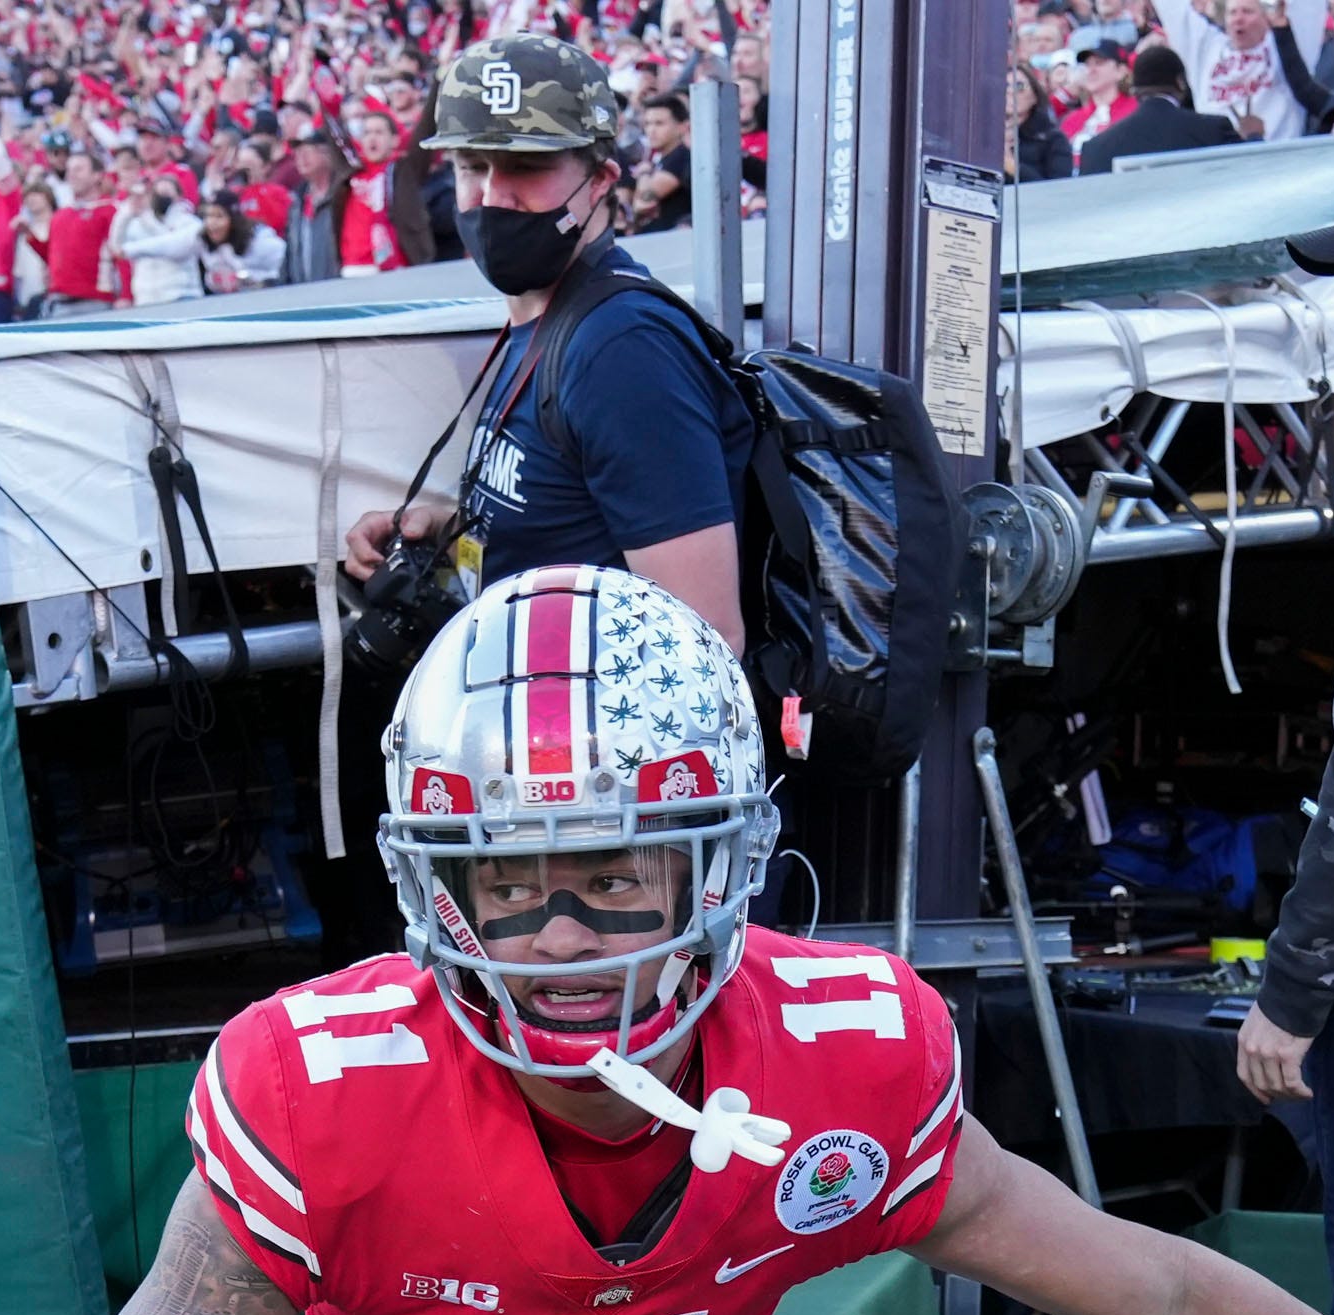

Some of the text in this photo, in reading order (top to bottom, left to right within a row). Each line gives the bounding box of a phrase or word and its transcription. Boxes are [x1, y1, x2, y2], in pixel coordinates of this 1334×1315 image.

[481, 61, 521, 115] SD
[833, 36, 855, 142] SUPER
[827, 147, 851, 241] Genie
[433, 892, 460, 927] OHIO
[281, 983, 430, 1085] 11
[770, 954, 907, 1043] 11
[780, 1135, 884, 1203] ROSE BOWL GAME
[807, 1194, 841, 1212] presented
